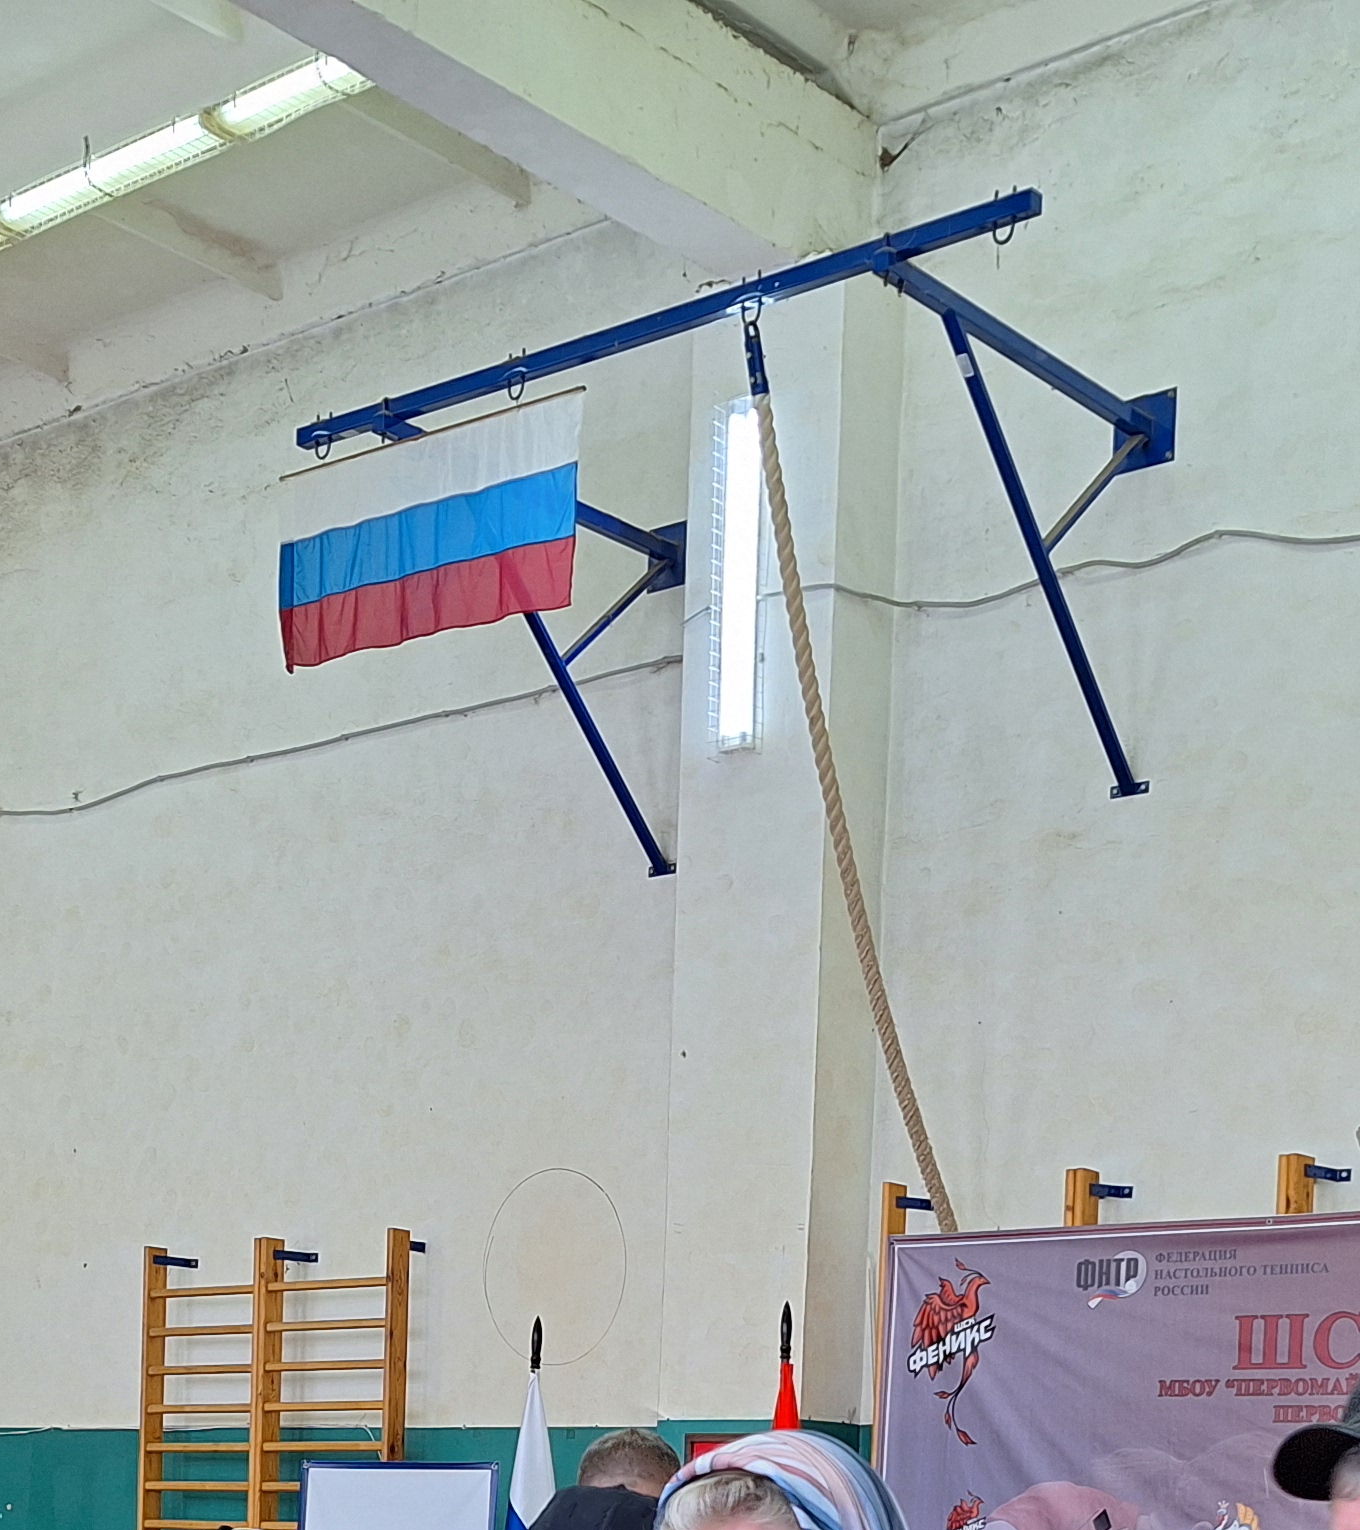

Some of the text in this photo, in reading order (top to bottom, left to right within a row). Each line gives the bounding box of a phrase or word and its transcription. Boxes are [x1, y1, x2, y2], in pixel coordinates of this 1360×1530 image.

[1155, 1249, 1237, 1264] ФЕДЕРАЦИЯ
[1075, 1257, 1139, 1292] ФНТР
[1154, 1265, 1257, 1281] НАСТОЛЬНОГО
[1153, 1284, 1209, 1297] РОССИИ
[908, 1318, 993, 1373] ФЕНИКС
[1158, 1379, 1220, 1397] МБОУ
[1225, 1373, 1360, 1397] “ПЕРВОМАЙ
[1272, 1405, 1347, 1423] ПЕРВО
